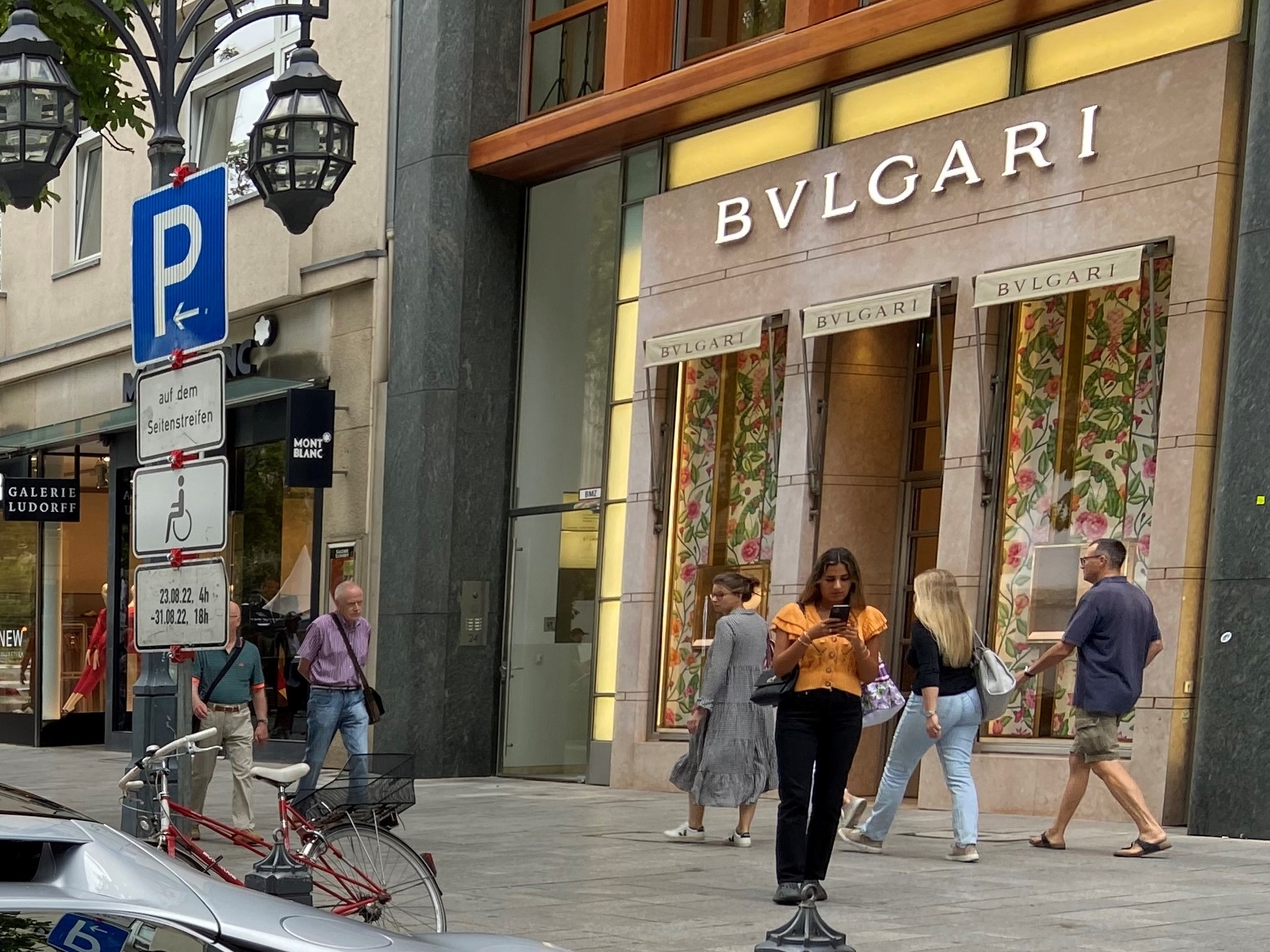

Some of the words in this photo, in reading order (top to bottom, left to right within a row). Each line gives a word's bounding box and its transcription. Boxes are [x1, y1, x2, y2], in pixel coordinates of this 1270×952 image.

[715, 103, 1101, 245] BVLGARI
[153, 204, 202, 338] P
[997, 262, 1116, 297] BVLGARI
[816, 298, 919, 329] BVLGARI
[660, 330, 744, 358] BVLGARI
[159, 388, 174, 404] auf
[177, 385, 198, 400] dem
[147, 410, 213, 435] Seitenstreifen
[293, 438, 323, 448] MONT
[293, 448, 323, 458] BLANC
[8, 486, 77, 498] GALERIE
[585, 489, 598, 498] BMZ
[8, 501, 77, 513] LUDORFF
[159, 587, 194, 604] 23.08.22,
[199, 586, 209, 603] 4h
[194, 608, 209, 624] 18h
